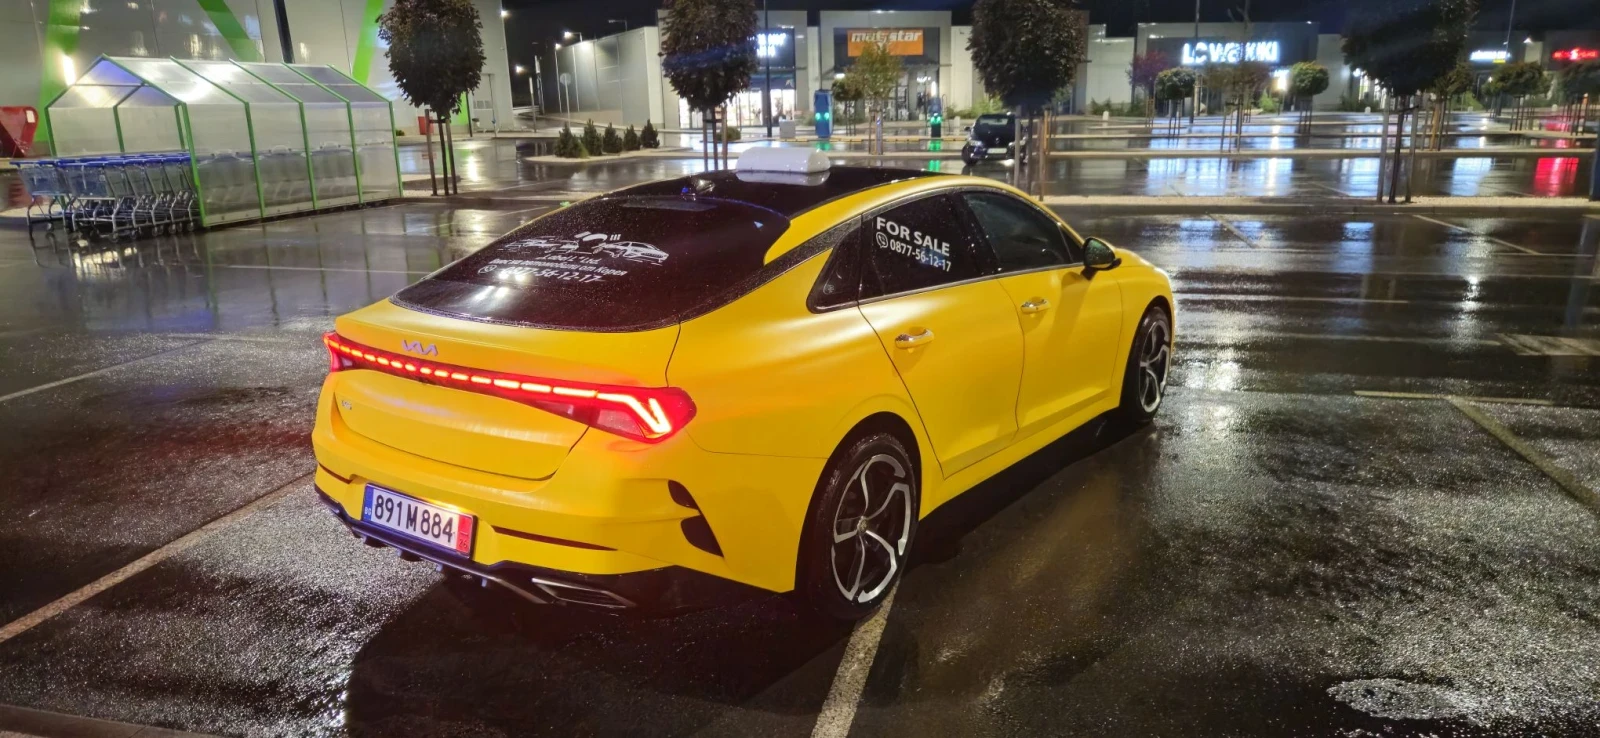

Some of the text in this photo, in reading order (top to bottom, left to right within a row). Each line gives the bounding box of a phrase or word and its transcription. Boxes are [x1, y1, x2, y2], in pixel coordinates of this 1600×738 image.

[876, 216, 950, 257] FOR SALE
[889, 239, 951, 272] 0877-56-12-17
